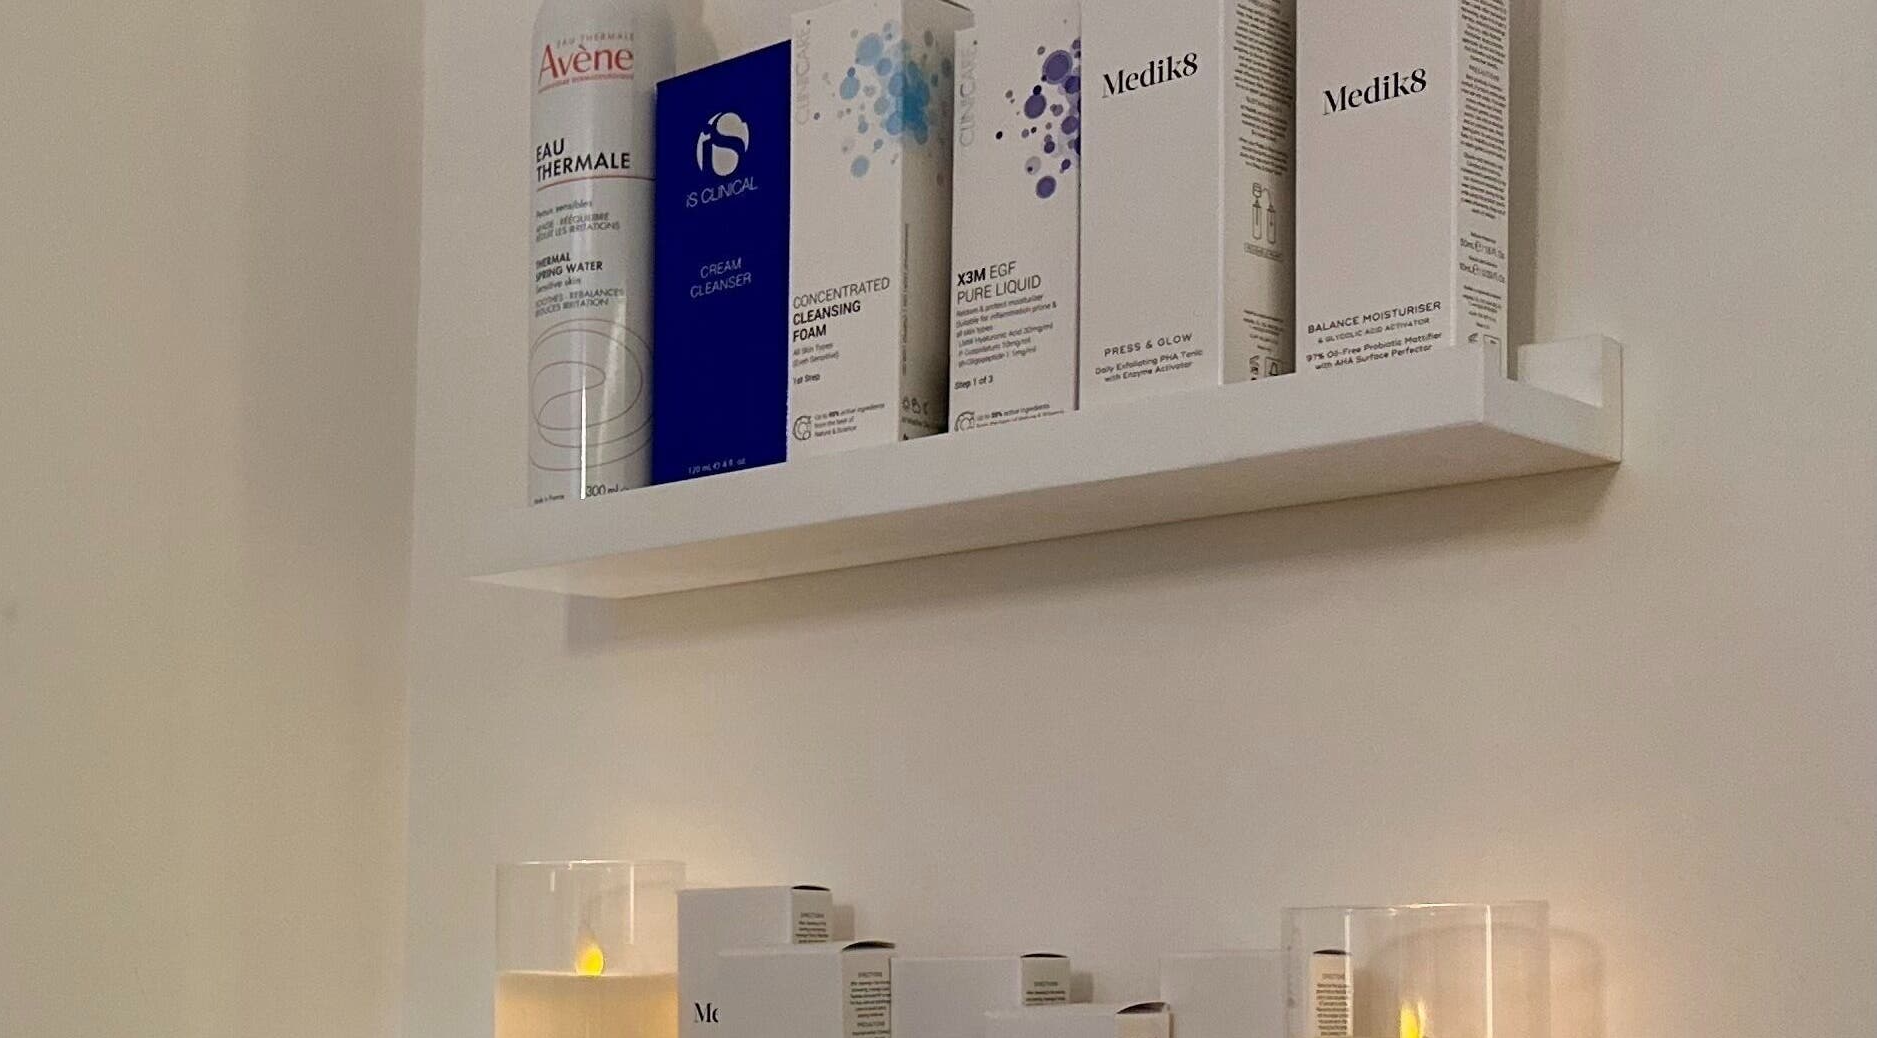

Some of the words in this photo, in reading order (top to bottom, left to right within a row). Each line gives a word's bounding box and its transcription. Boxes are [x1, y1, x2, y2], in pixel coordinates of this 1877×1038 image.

[538, 43, 634, 85] Avène
[1101, 52, 1198, 99] Medik8
[1322, 68, 1427, 116] Medik8
[536, 138, 564, 162] EAU
[537, 152, 631, 182] THERMALE
[700, 176, 759, 204] CLINICAL
[565, 260, 603, 273] WATER
[700, 257, 742, 279] CREAM
[956, 268, 986, 287] X3M
[989, 260, 1017, 279] EGF
[690, 272, 752, 298] CLEANSER
[793, 276, 890, 309] CONCENTRATED
[956, 285, 992, 305] PURE
[995, 274, 1042, 297] LIQUID
[793, 300, 861, 326] CLEANSING
[1307, 316, 1360, 334] BALANCE
[1362, 300, 1442, 324] MOISTURISER
[793, 324, 827, 343] FOAM
[1325, 328, 1363, 343] GLYCOLIC
[1365, 325, 1383, 336] ACID
[1385, 317, 1430, 332] ACTIVATOR
[1104, 342, 1142, 357] PRESS
[1145, 339, 1153, 350] &
[1157, 332, 1193, 347] GLOW
[1355, 351, 1389, 365] Surface
[1391, 343, 1433, 358] Perfector
[1363, 337, 1402, 353] Probiotic
[1095, 364, 1114, 376] Daily
[1116, 356, 1158, 372] Exfoliating
[1121, 367, 1153, 381] Enzyme
[1155, 361, 1193, 374] Activator
[954, 378, 971, 390] Step
